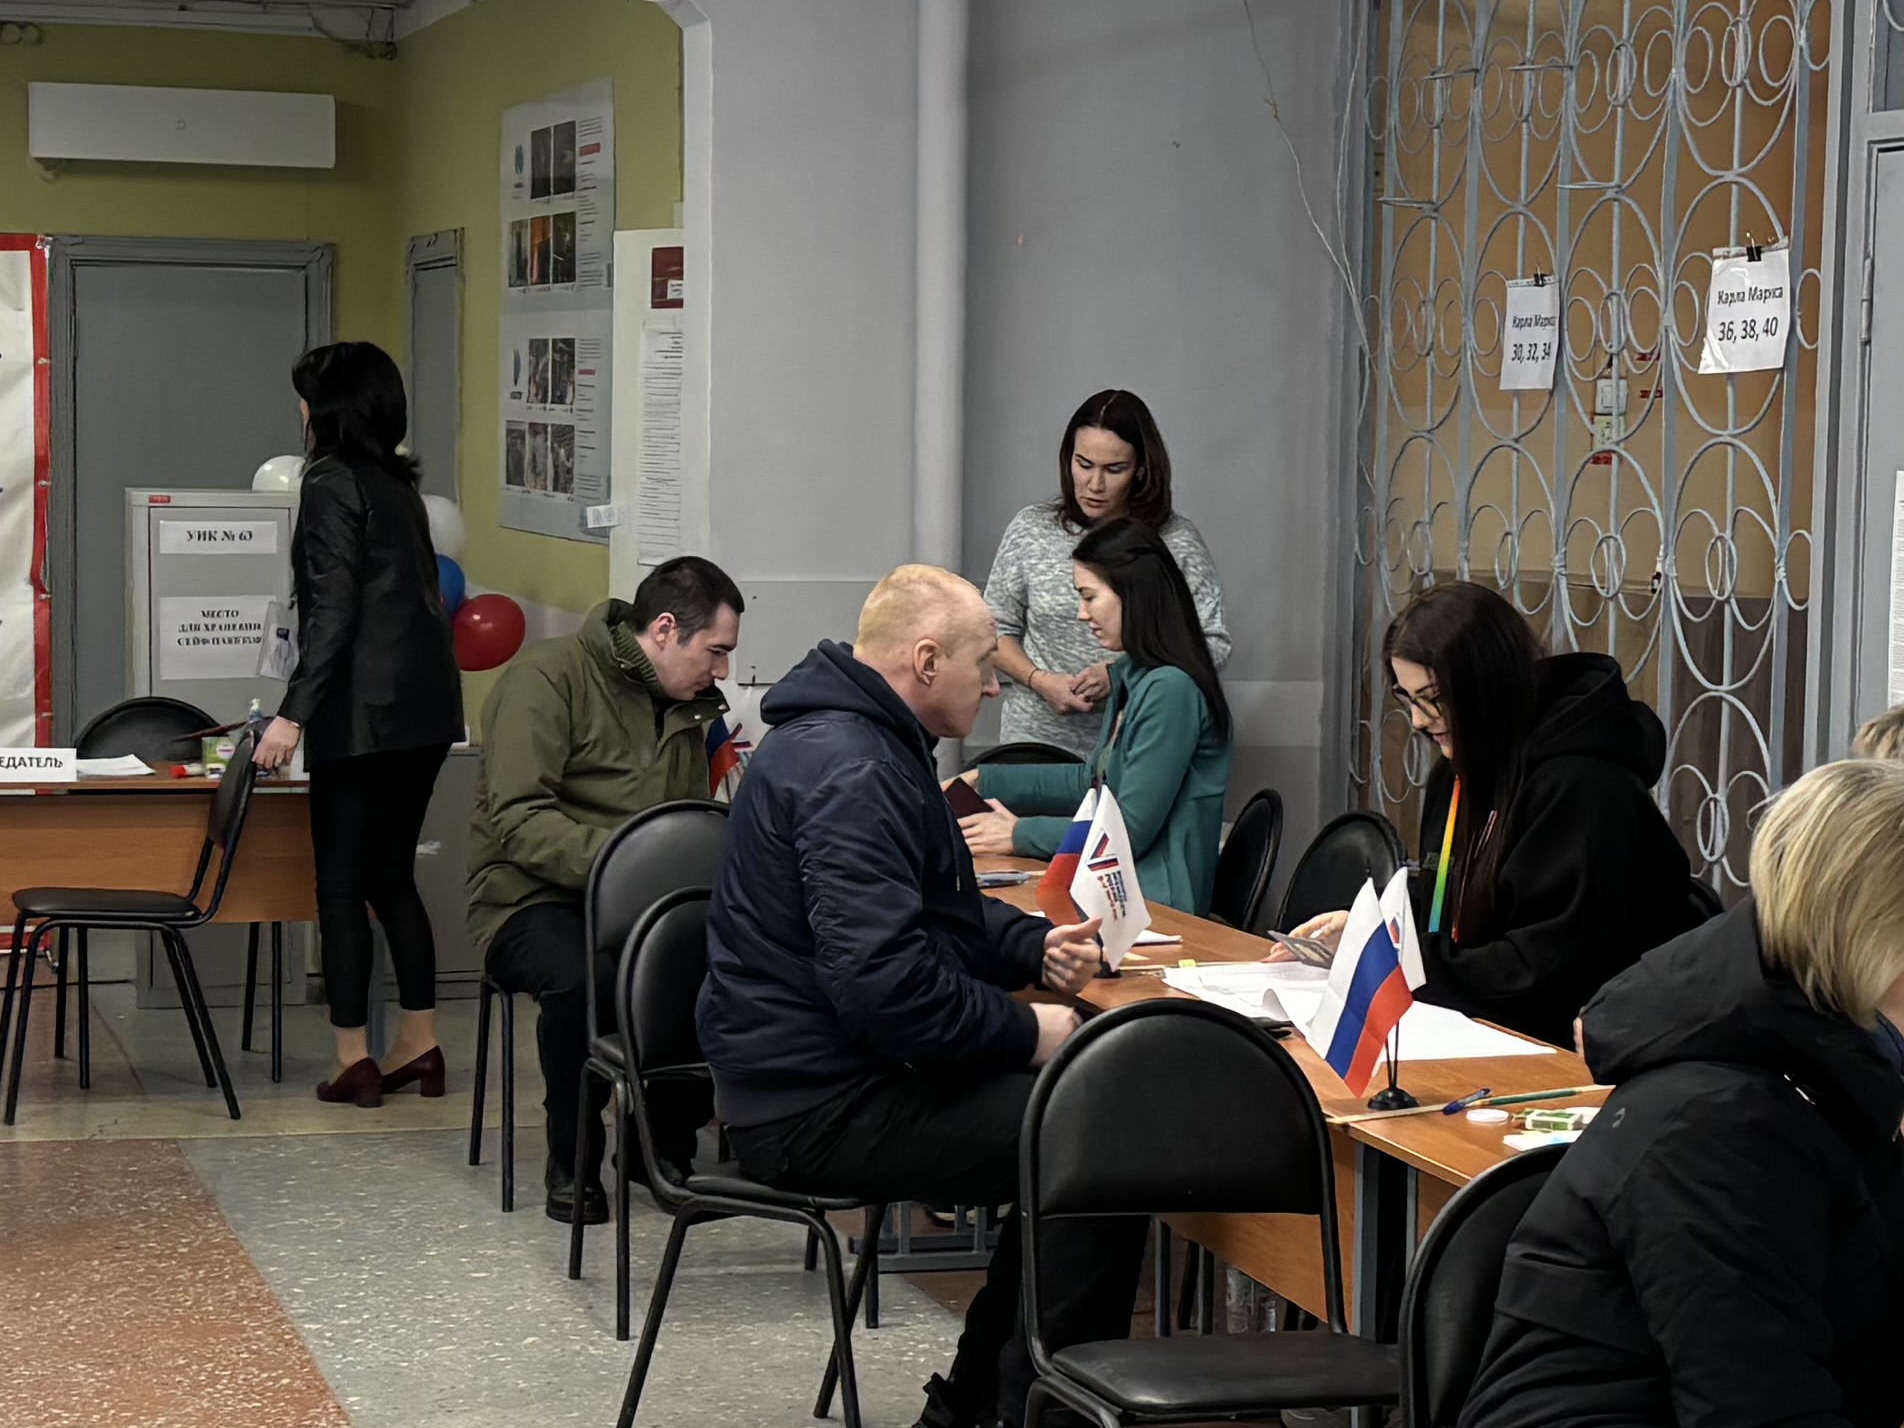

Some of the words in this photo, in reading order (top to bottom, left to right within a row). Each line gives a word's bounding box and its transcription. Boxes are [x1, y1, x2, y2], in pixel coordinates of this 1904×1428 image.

[1718, 290, 1745, 307] Карла
[1718, 321, 1737, 343] 36,
[1740, 318, 1759, 342] 38,
[1763, 316, 1778, 337] 40
[186, 530, 217, 542] УИК
